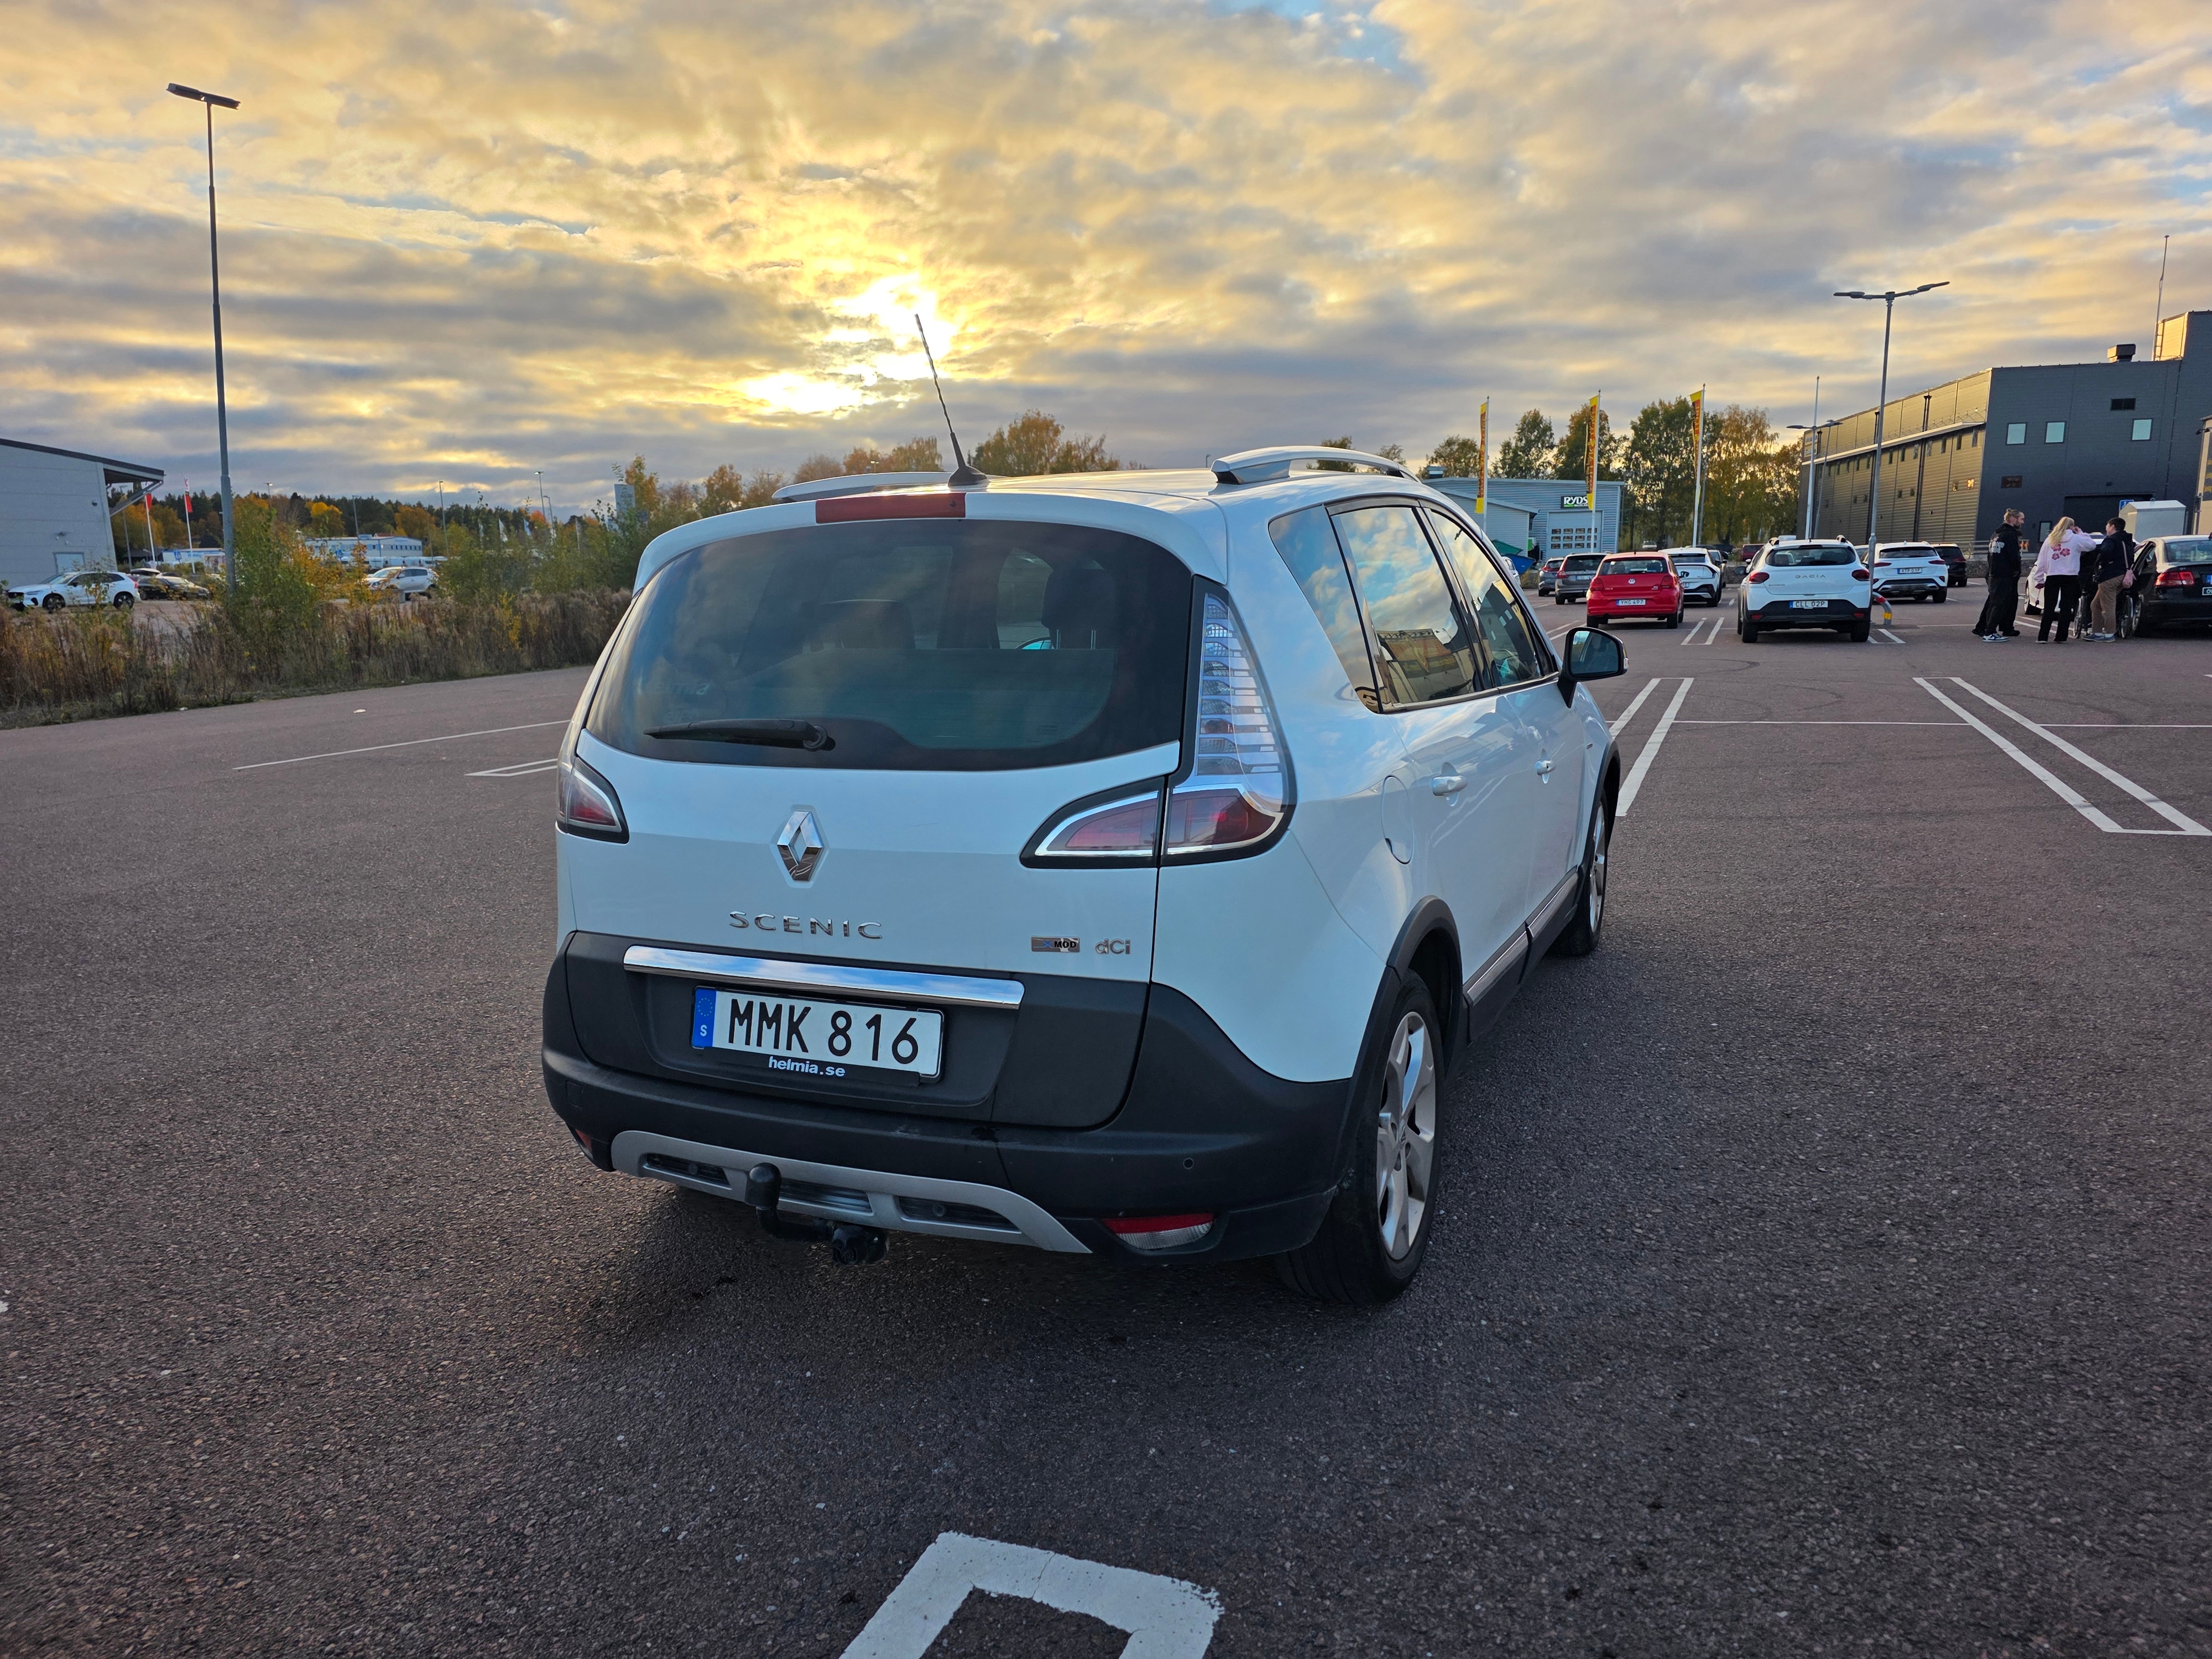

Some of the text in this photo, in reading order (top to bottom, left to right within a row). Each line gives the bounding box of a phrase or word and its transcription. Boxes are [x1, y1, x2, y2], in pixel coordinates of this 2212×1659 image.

[729, 911, 883, 939] SCENIC
[1095, 938, 1130, 954] dCi
[700, 1025, 707, 1037] S
[728, 999, 919, 1065] MMK 816
[769, 1056, 846, 1077] helmia.se
